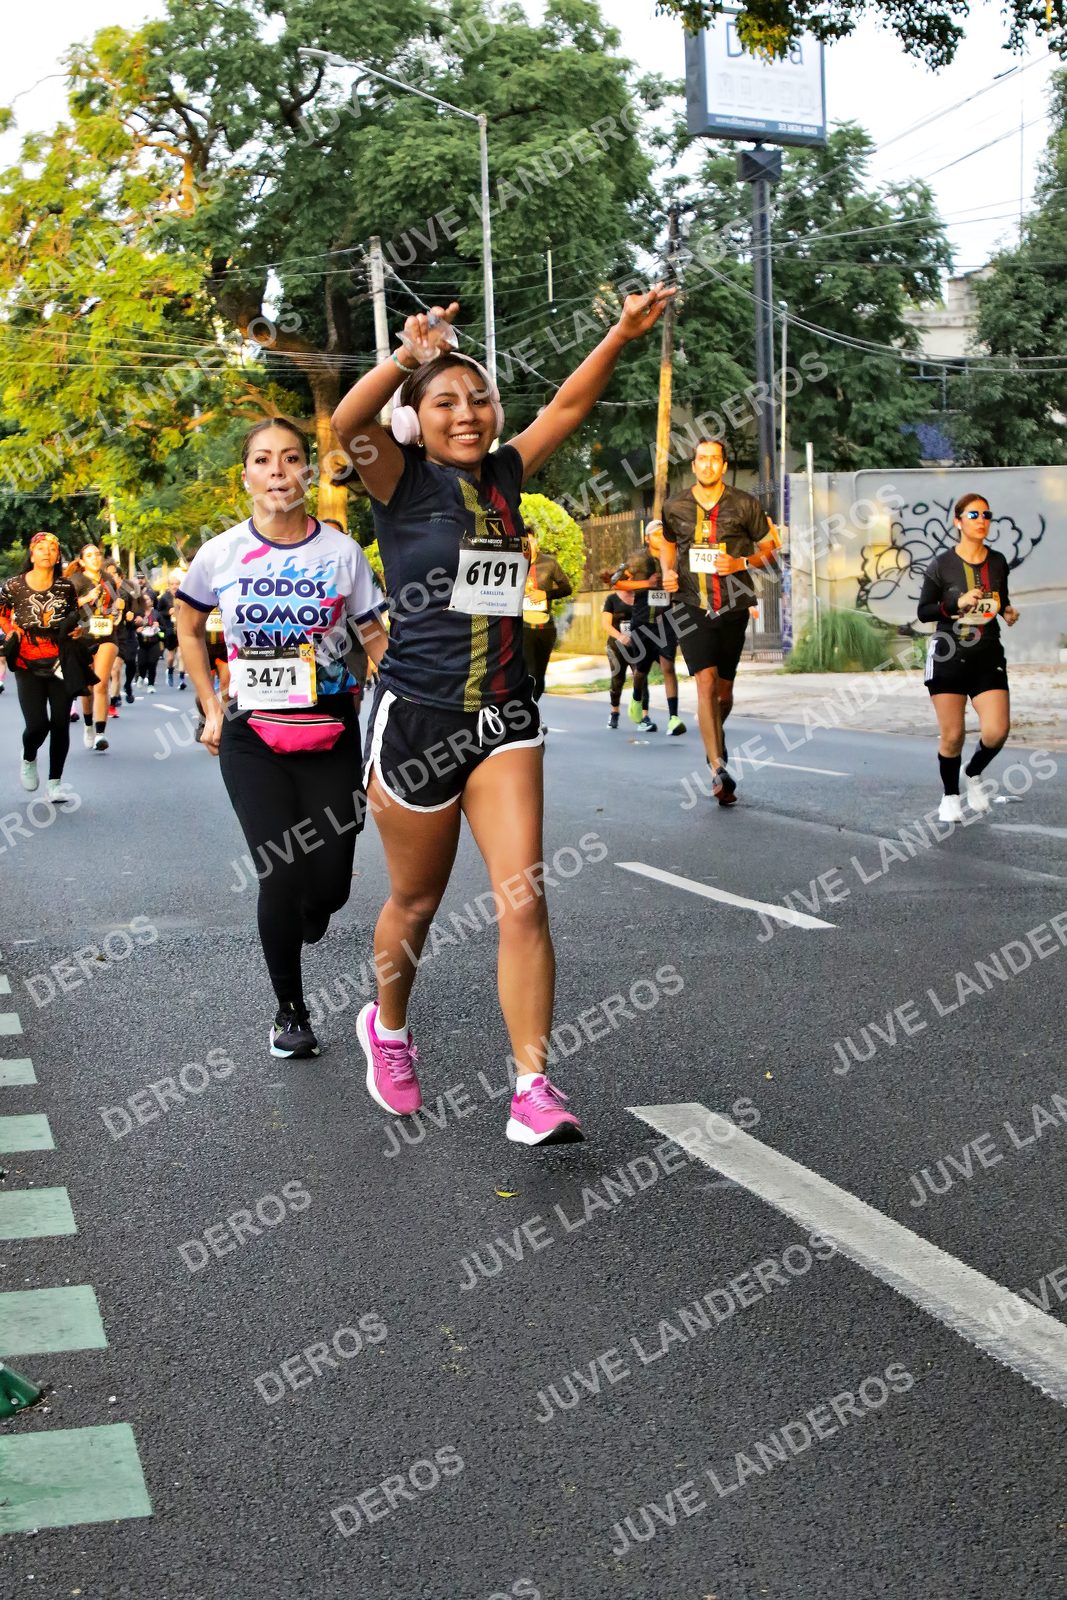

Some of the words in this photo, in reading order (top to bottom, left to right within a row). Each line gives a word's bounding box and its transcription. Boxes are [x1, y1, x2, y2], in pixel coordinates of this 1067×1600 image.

[466, 560, 519, 588] 6191
[238, 578, 328, 599] TODOS
[235, 603, 331, 627] SOMOS
[246, 666, 297, 688] 3471
